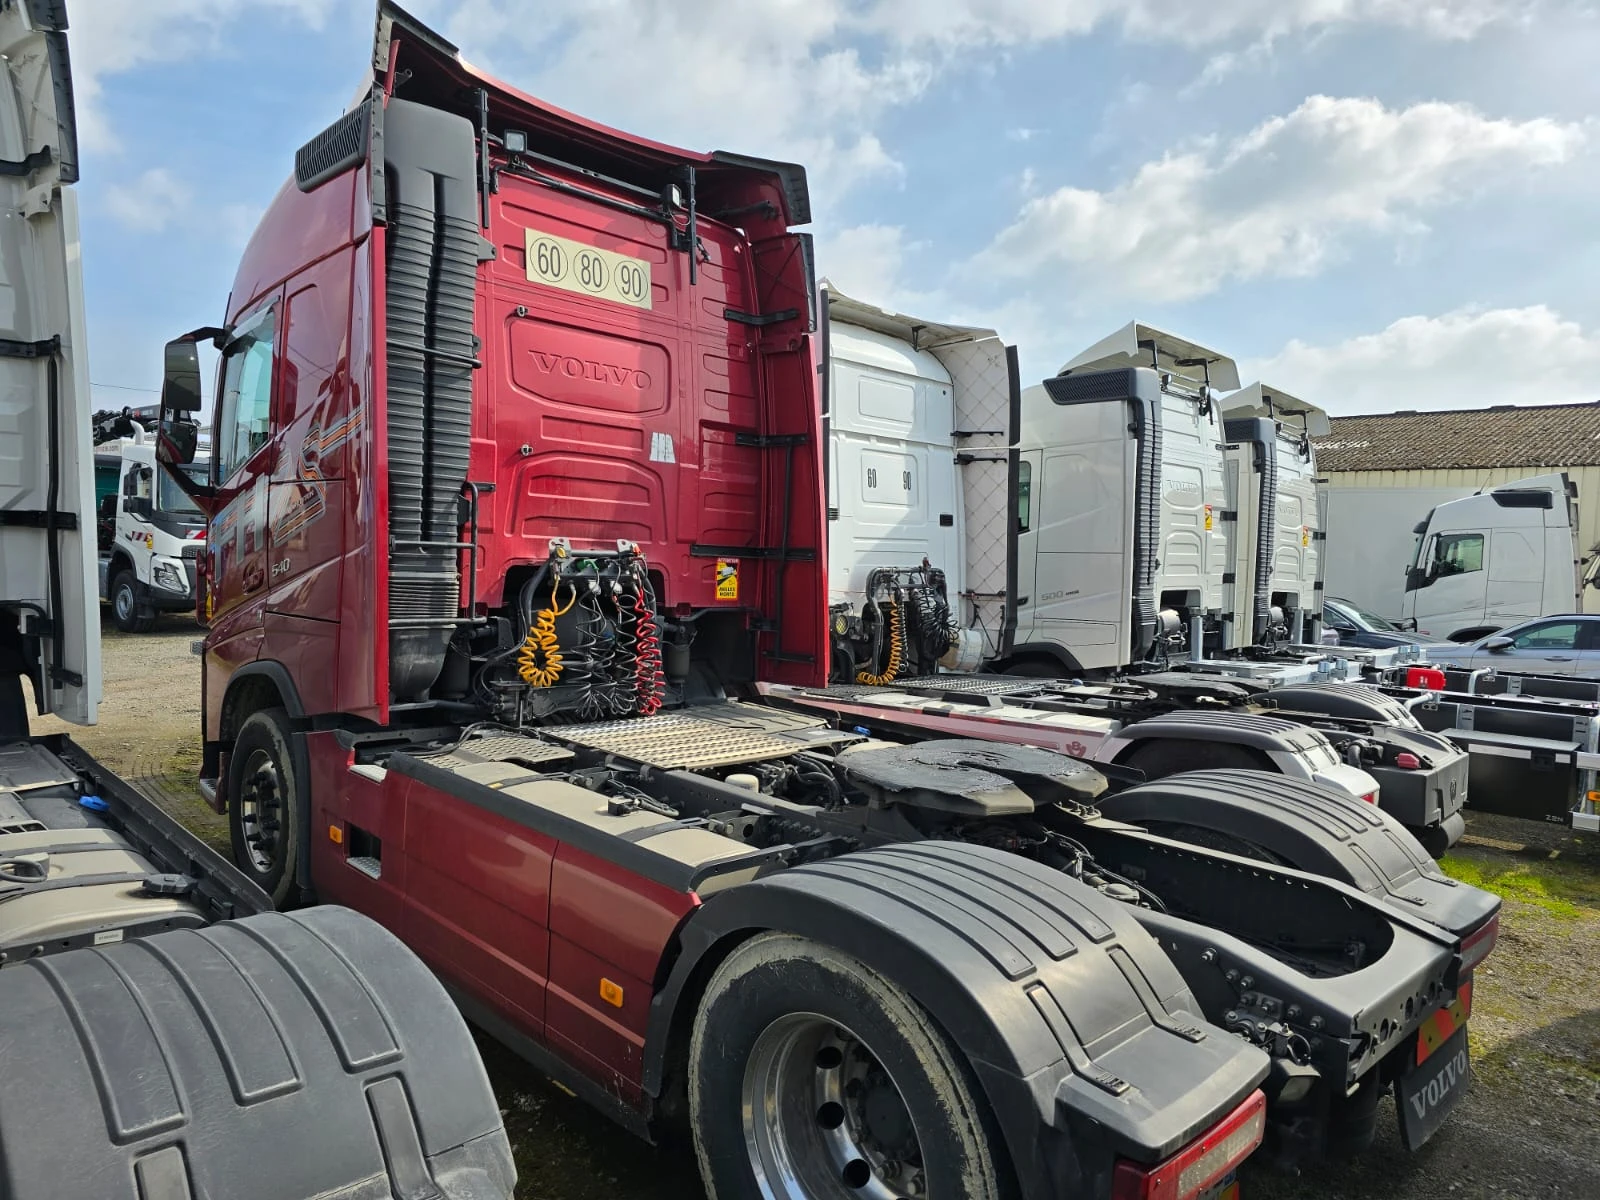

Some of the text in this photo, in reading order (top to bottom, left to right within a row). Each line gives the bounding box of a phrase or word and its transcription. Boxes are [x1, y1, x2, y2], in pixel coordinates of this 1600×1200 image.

[538, 242, 642, 298] 60 80 90
[528, 349, 652, 390] VOLVO
[867, 467, 912, 491] 60 90
[271, 558, 290, 577] 540
[1040, 590, 1064, 601] 500
[1410, 1049, 1466, 1119] VOLVO
